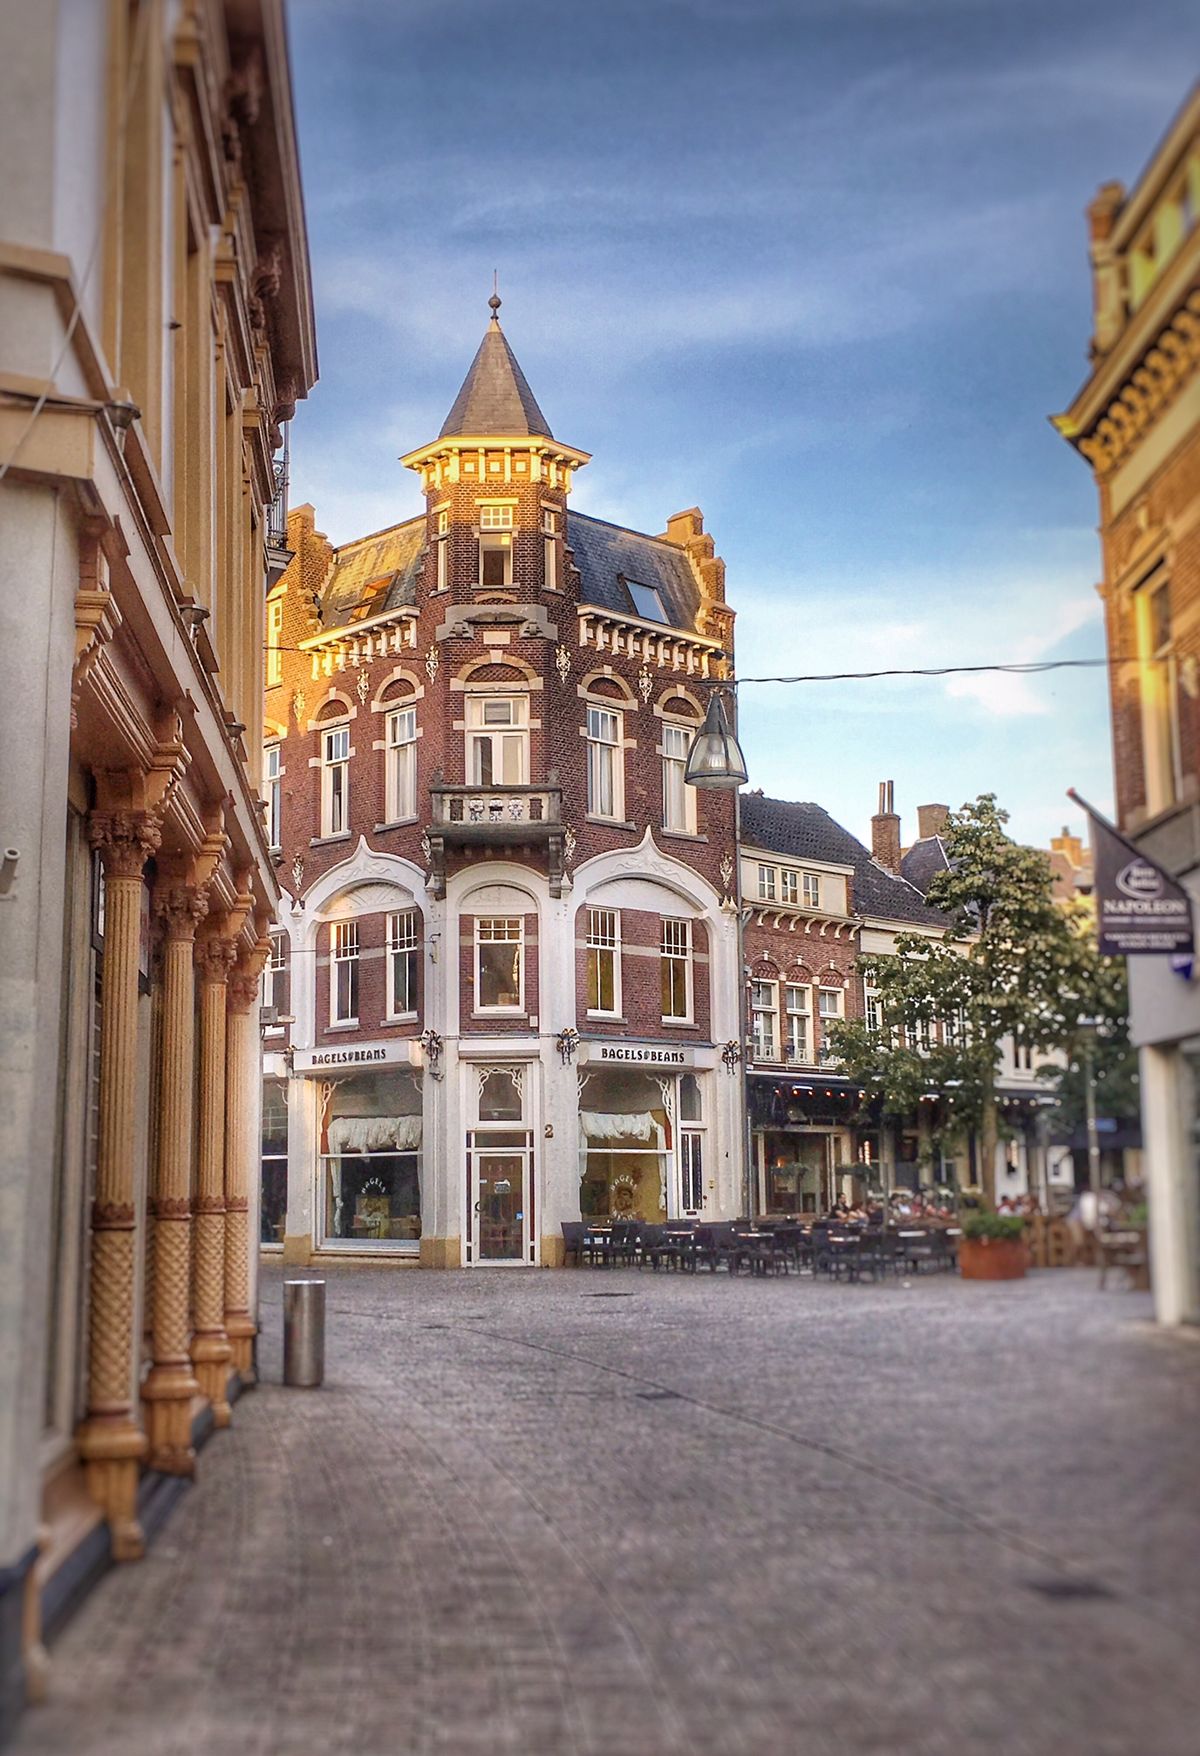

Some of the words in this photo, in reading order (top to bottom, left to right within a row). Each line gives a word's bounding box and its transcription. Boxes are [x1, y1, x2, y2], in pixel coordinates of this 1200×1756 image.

[1103, 899, 1187, 915] NAPOLEON
[312, 1052, 347, 1065] BAGELS
[355, 1049, 386, 1061] BEANS
[602, 1048, 643, 1060] BAGELS
[651, 1051, 685, 1063] BEANS
[545, 1124, 554, 1138] 2
